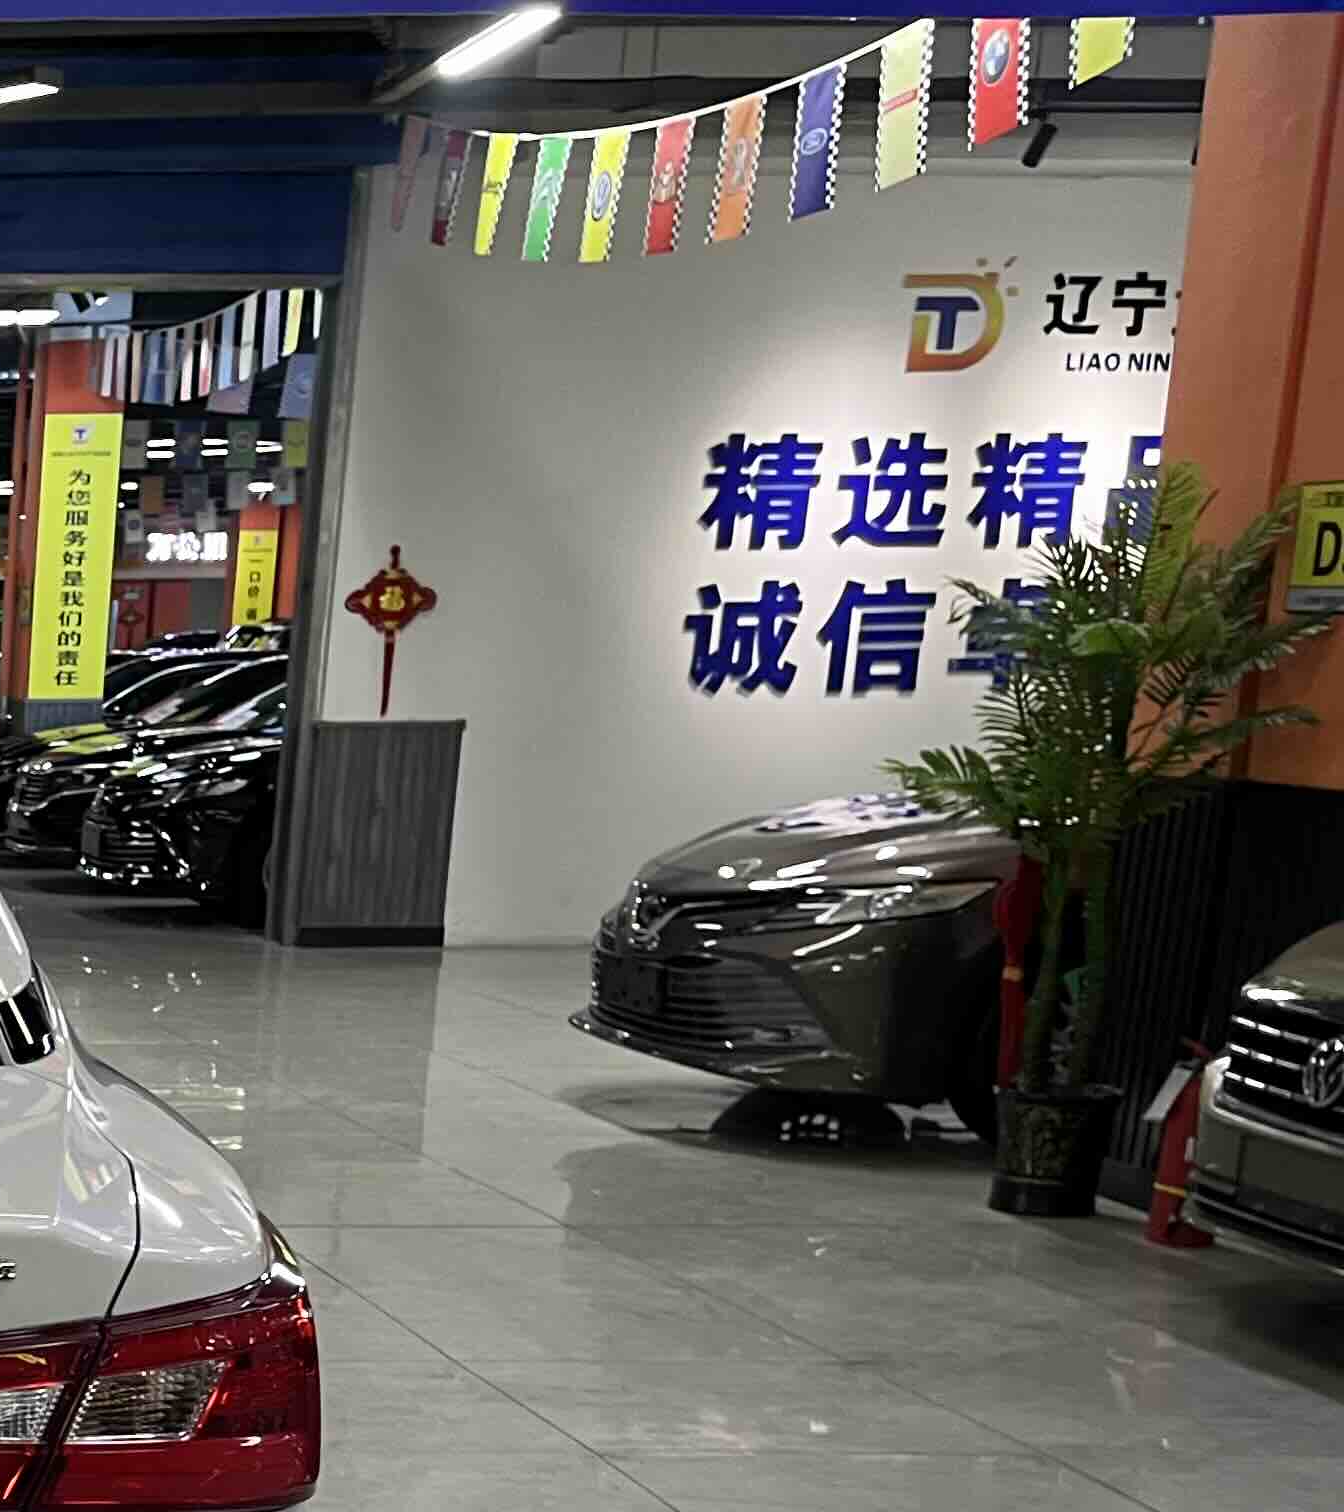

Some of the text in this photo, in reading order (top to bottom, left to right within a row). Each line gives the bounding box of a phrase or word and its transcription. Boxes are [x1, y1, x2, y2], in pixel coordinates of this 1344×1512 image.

[1043, 272, 1182, 337] 辽宁
[1066, 352, 1121, 372] LIAO
[53, 468, 91, 687] 为您服务好是我们的责任
[1312, 520, 1344, 577] D
